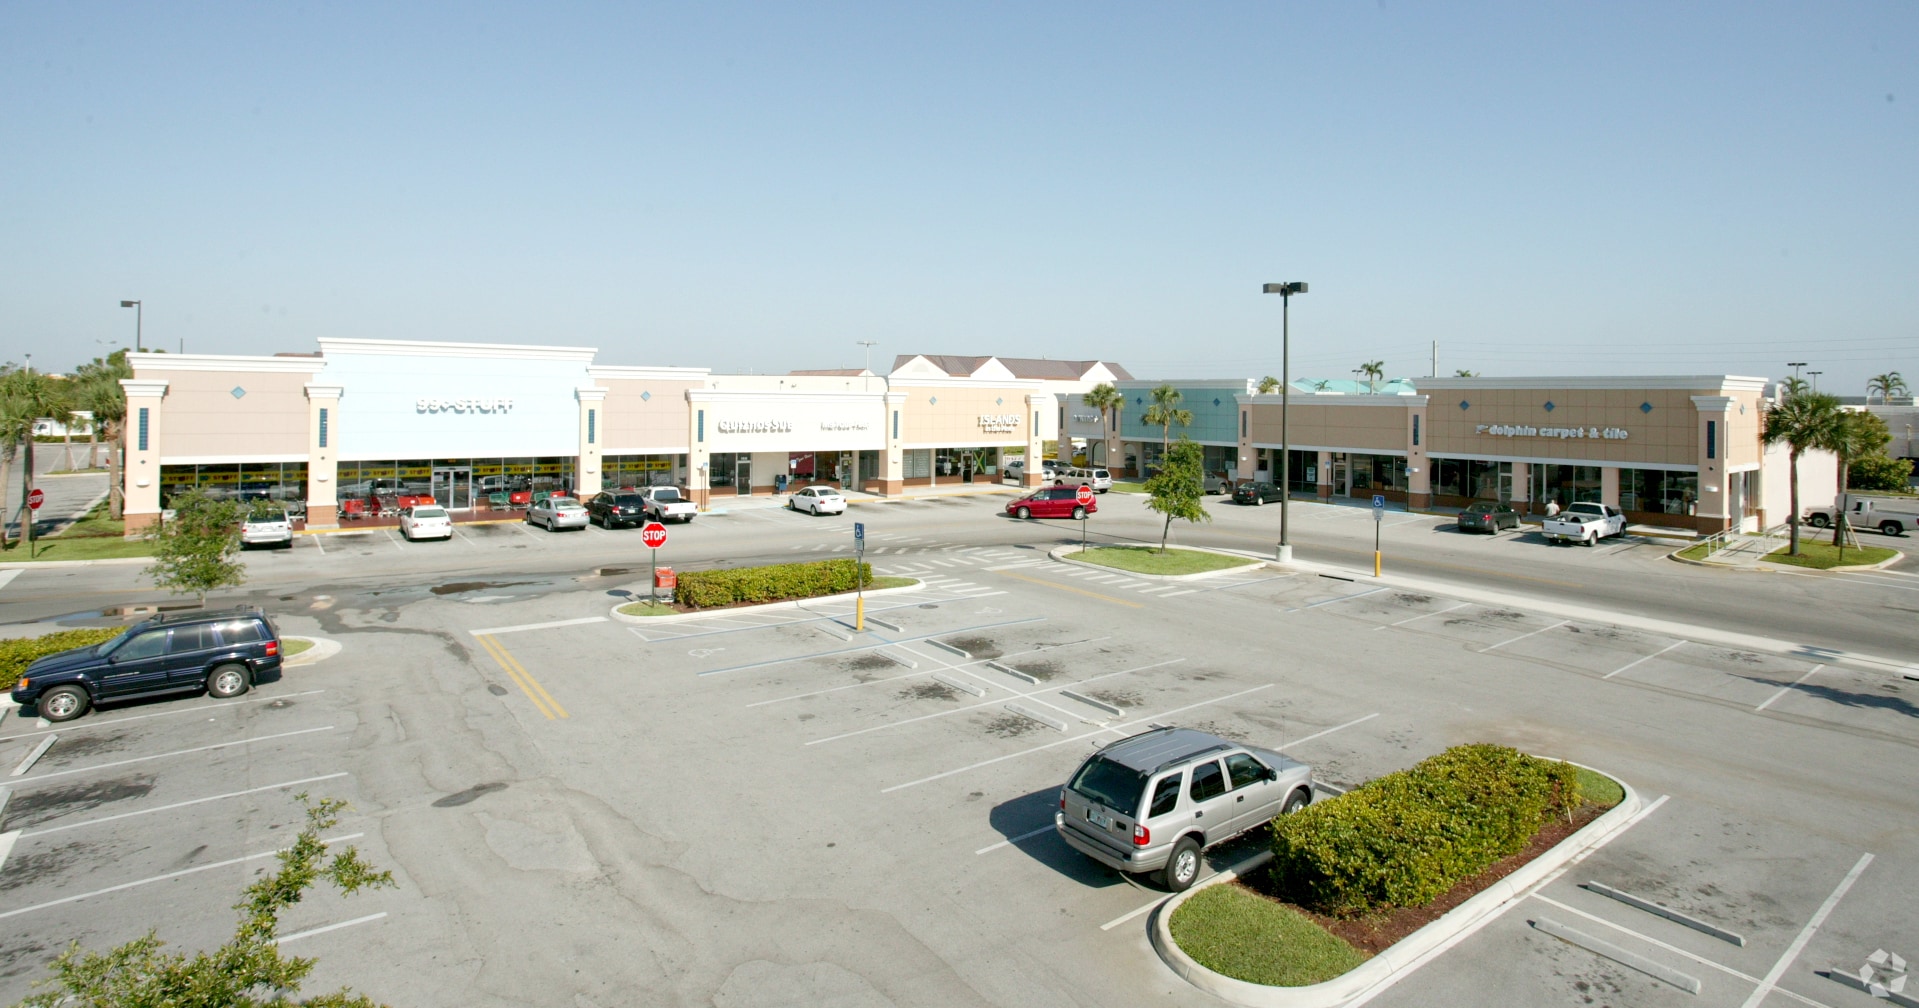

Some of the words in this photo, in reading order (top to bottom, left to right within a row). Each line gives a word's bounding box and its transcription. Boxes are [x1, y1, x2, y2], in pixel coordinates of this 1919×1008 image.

[978, 414, 1022, 426] ISLANDS
[1488, 424, 1537, 438] dolphin
[1538, 426, 1584, 440] carpet
[1588, 427, 1600, 439] &
[1602, 427, 1629, 440] tile
[1077, 491, 1091, 499] STOP
[643, 530, 666, 541] STOP
